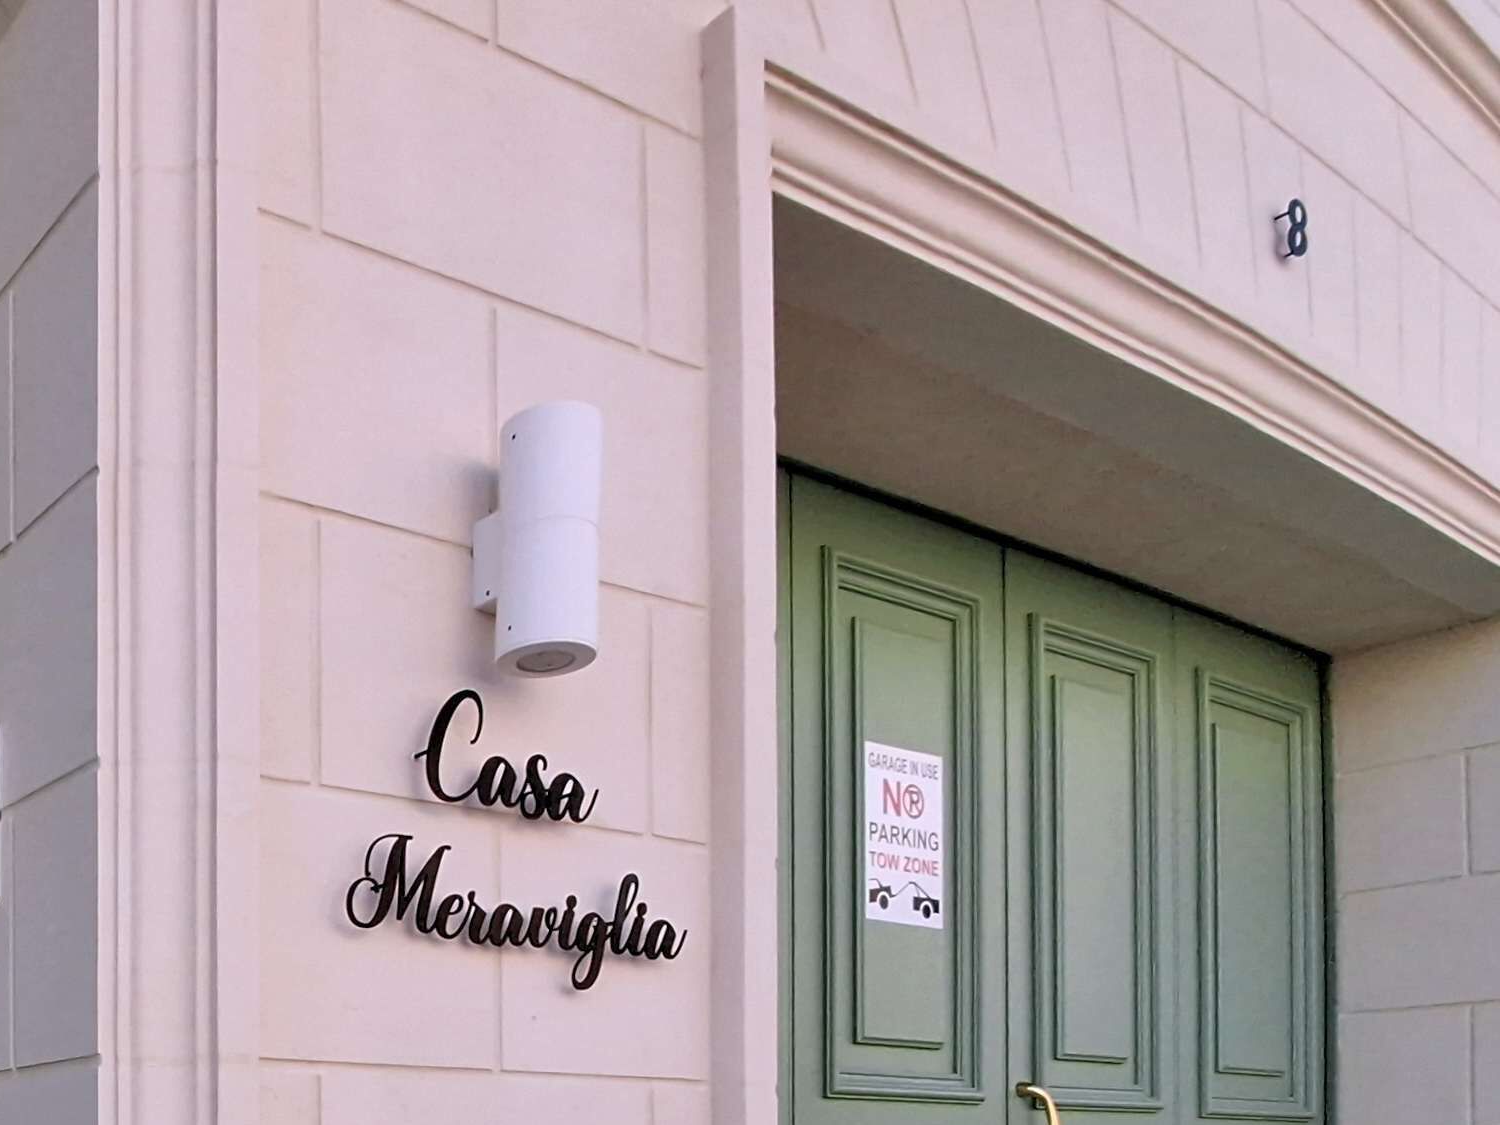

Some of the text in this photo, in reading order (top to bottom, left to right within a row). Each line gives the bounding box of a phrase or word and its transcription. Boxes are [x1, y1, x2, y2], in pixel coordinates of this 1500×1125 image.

[1287, 198, 1308, 257] 8
[414, 689, 599, 823] Casa
[868, 752, 939, 780] GARAGE IN USE
[869, 821, 940, 852] PARKING
[869, 851, 940, 877] TOW ZONE
[345, 833, 688, 990] Meraviglia
